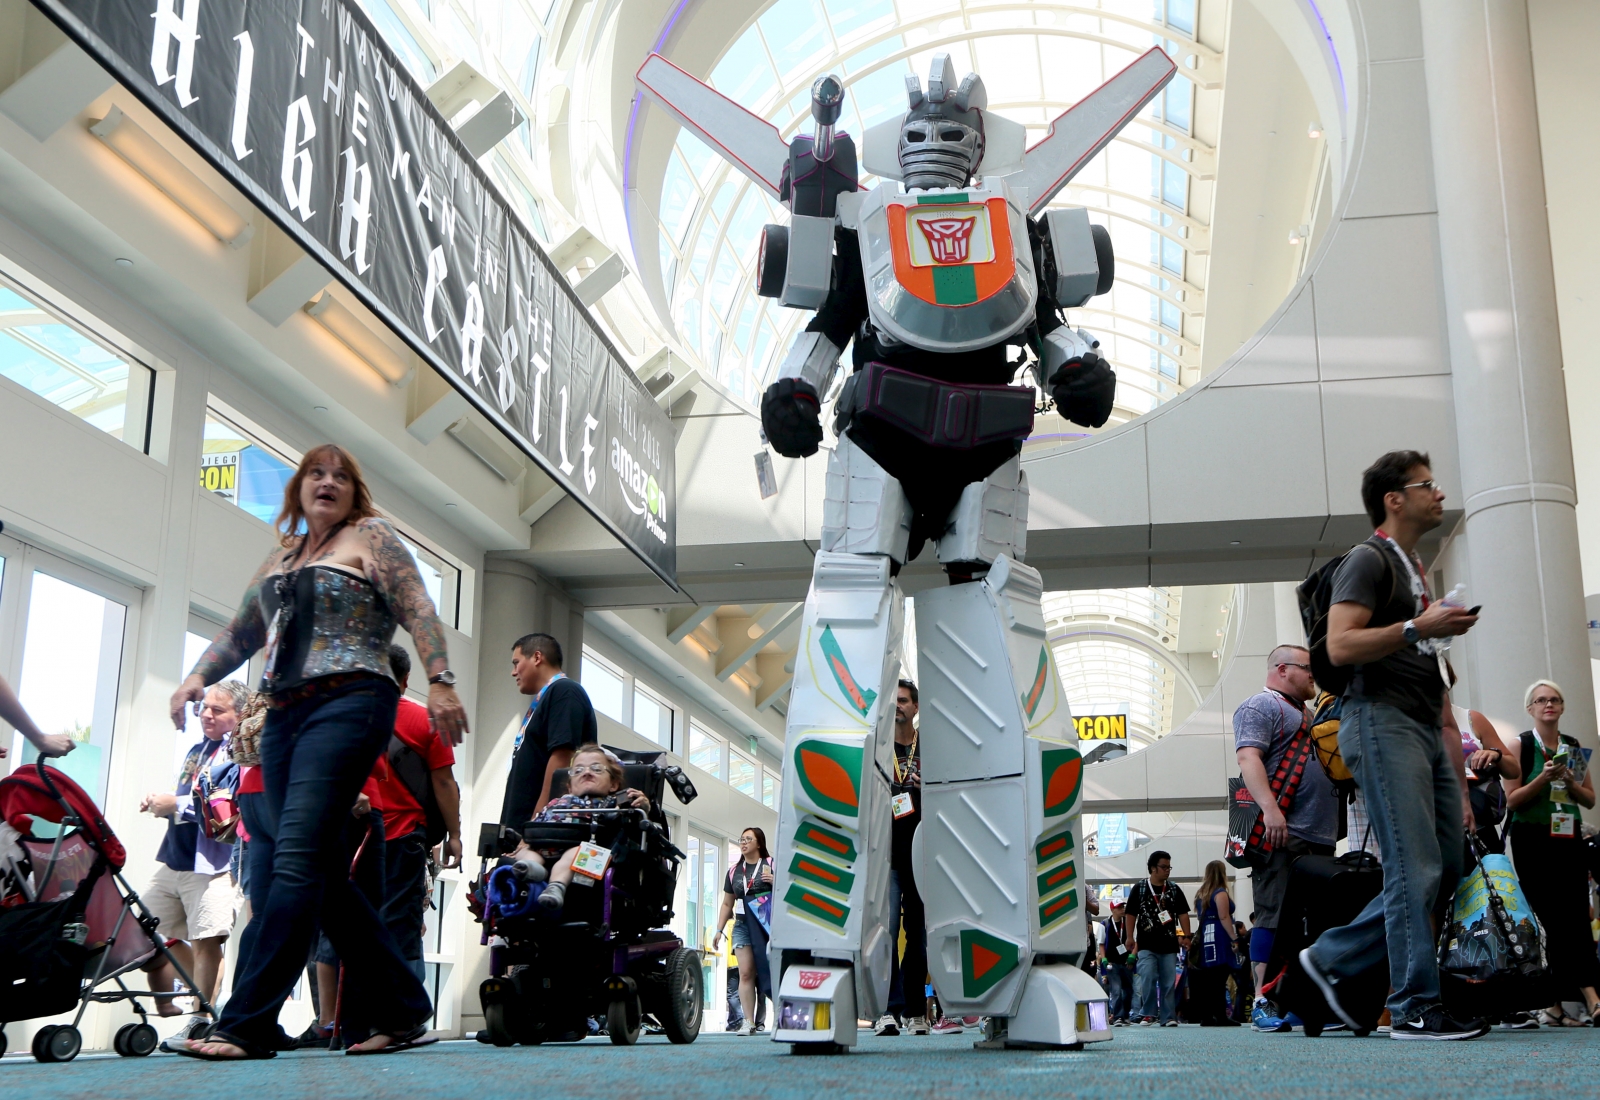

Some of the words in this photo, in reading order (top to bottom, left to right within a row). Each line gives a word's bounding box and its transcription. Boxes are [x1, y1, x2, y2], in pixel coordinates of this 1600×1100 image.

[320, 0, 412, 121] AMAZON
[296, 22, 370, 147] THE
[391, 137, 456, 246] MAN
[474, 234, 498, 295] IN
[514, 281, 553, 358] THE
[150, 0, 371, 276] HIGH
[423, 244, 599, 495] CASTLE
[618, 393, 637, 443] FALL
[642, 423, 660, 470] 2015
[611, 436, 666, 523] amazon
[1459, 879, 1517, 909] FAMLY
[1473, 929, 1489, 937] 2015
